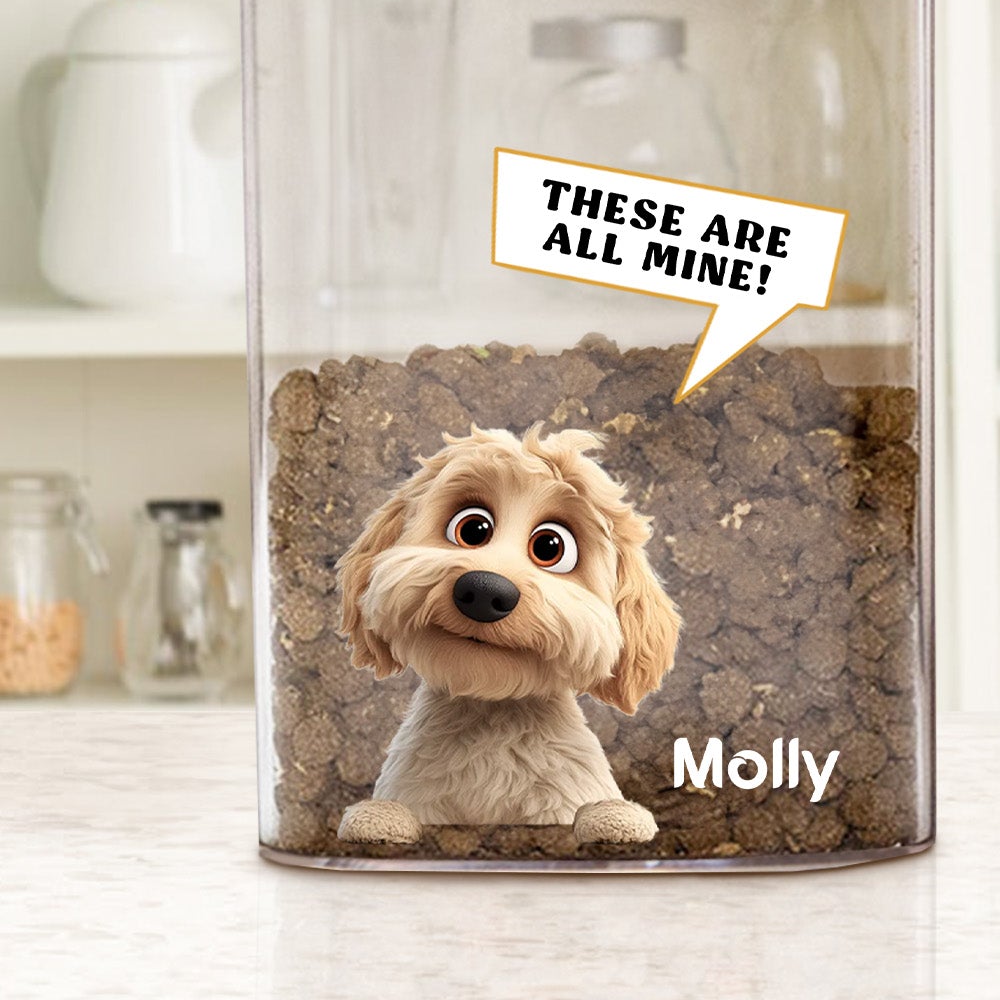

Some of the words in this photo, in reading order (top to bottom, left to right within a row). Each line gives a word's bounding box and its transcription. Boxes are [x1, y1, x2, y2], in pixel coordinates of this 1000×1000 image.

[542, 178, 685, 237] THESE
[700, 214, 791, 259] ARE
[542, 222, 623, 265] ALL
[642, 241, 772, 295] MINE!
[673, 737, 841, 803] Molly
